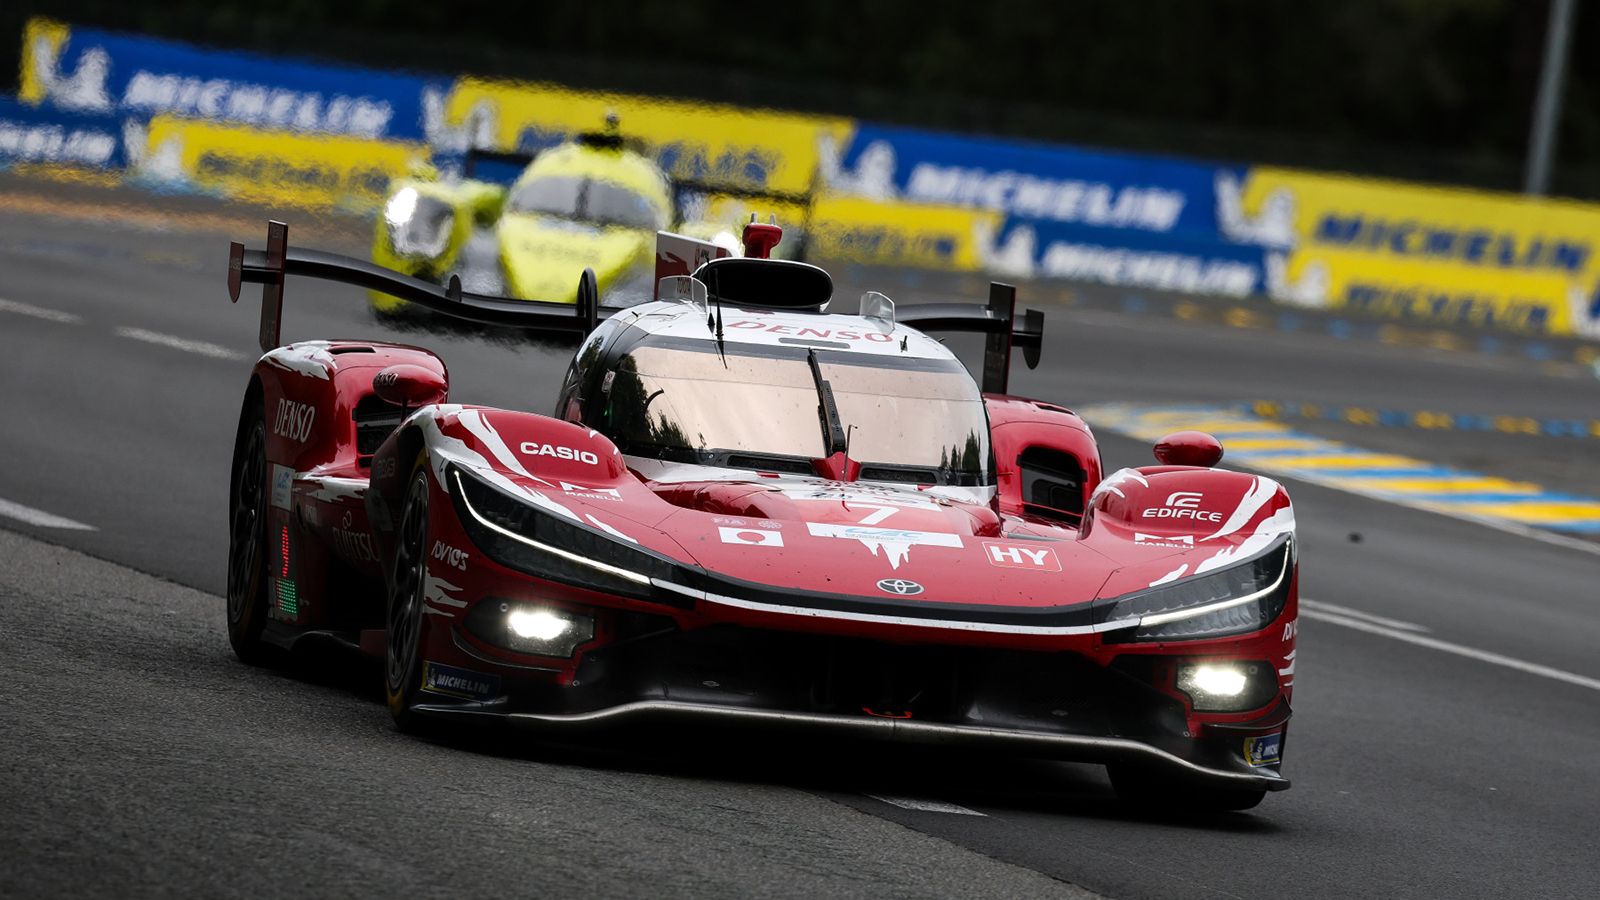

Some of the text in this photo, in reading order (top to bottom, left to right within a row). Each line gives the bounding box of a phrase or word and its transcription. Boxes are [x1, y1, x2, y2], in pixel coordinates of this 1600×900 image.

[124, 71, 391, 140] MICHELIN
[906, 162, 1183, 230] MICHELIN
[1314, 212, 1590, 273] MICHELIN
[1042, 240, 1258, 298] MICHELIN
[726, 319, 894, 344] DENSO
[274, 398, 316, 444] DENSO
[520, 442, 599, 465] CASIO
[565, 491, 624, 502] MARELLI
[846, 503, 900, 525] 7
[1142, 508, 1223, 523] EDIFICE
[989, 545, 1049, 566] HY
[1134, 541, 1194, 550] MARELLI
[436, 674, 490, 694] MICHELIN
